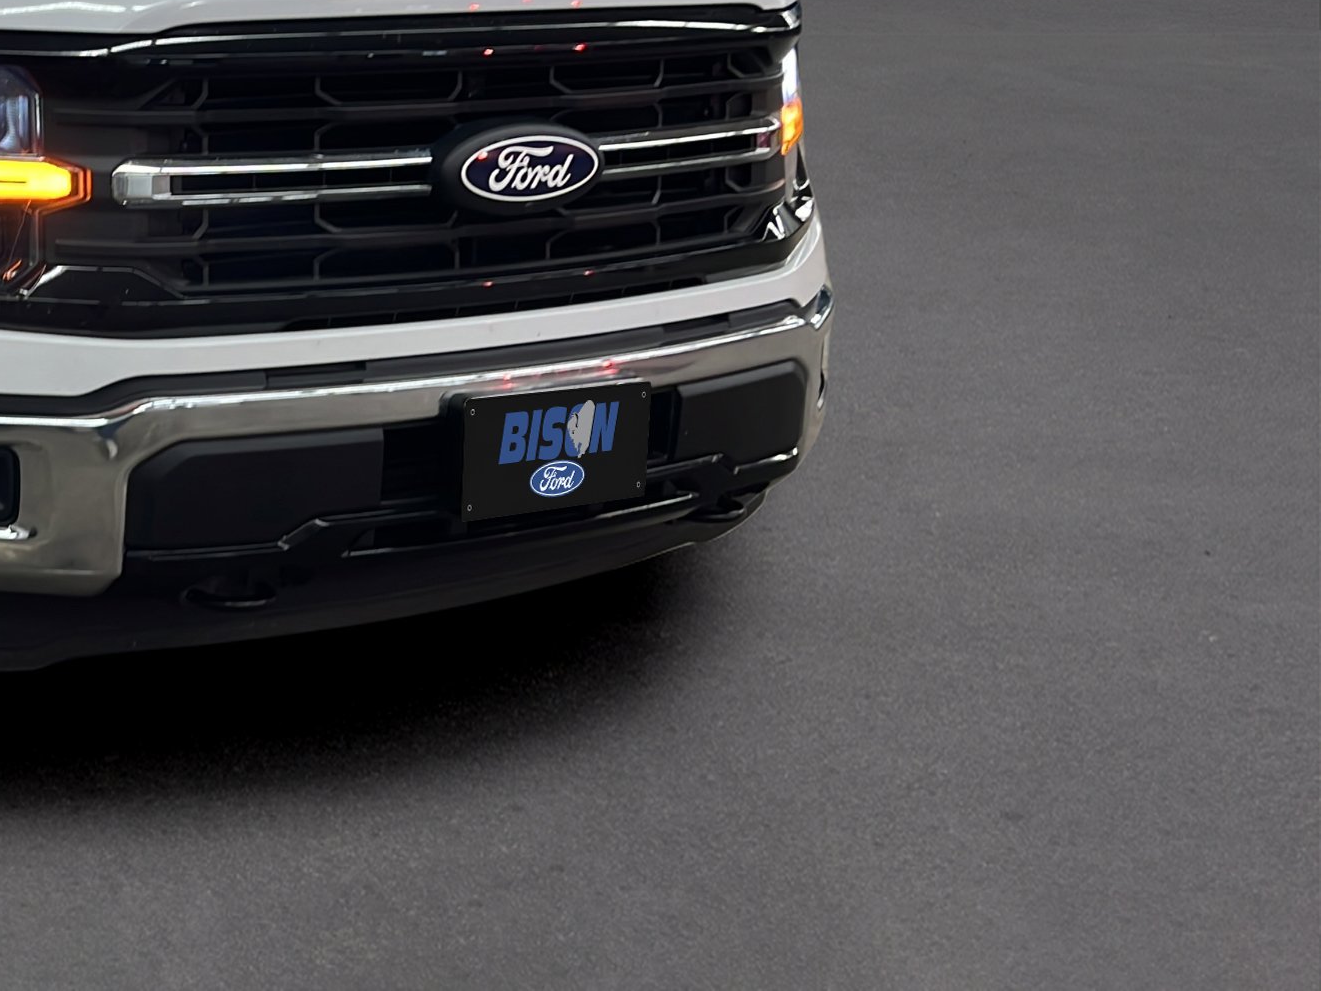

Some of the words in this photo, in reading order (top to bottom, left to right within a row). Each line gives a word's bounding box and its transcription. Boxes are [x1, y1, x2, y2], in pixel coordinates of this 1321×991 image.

[488, 145, 574, 192] Ford
[498, 401, 620, 465] BISON
[539, 466, 576, 492] Ford
